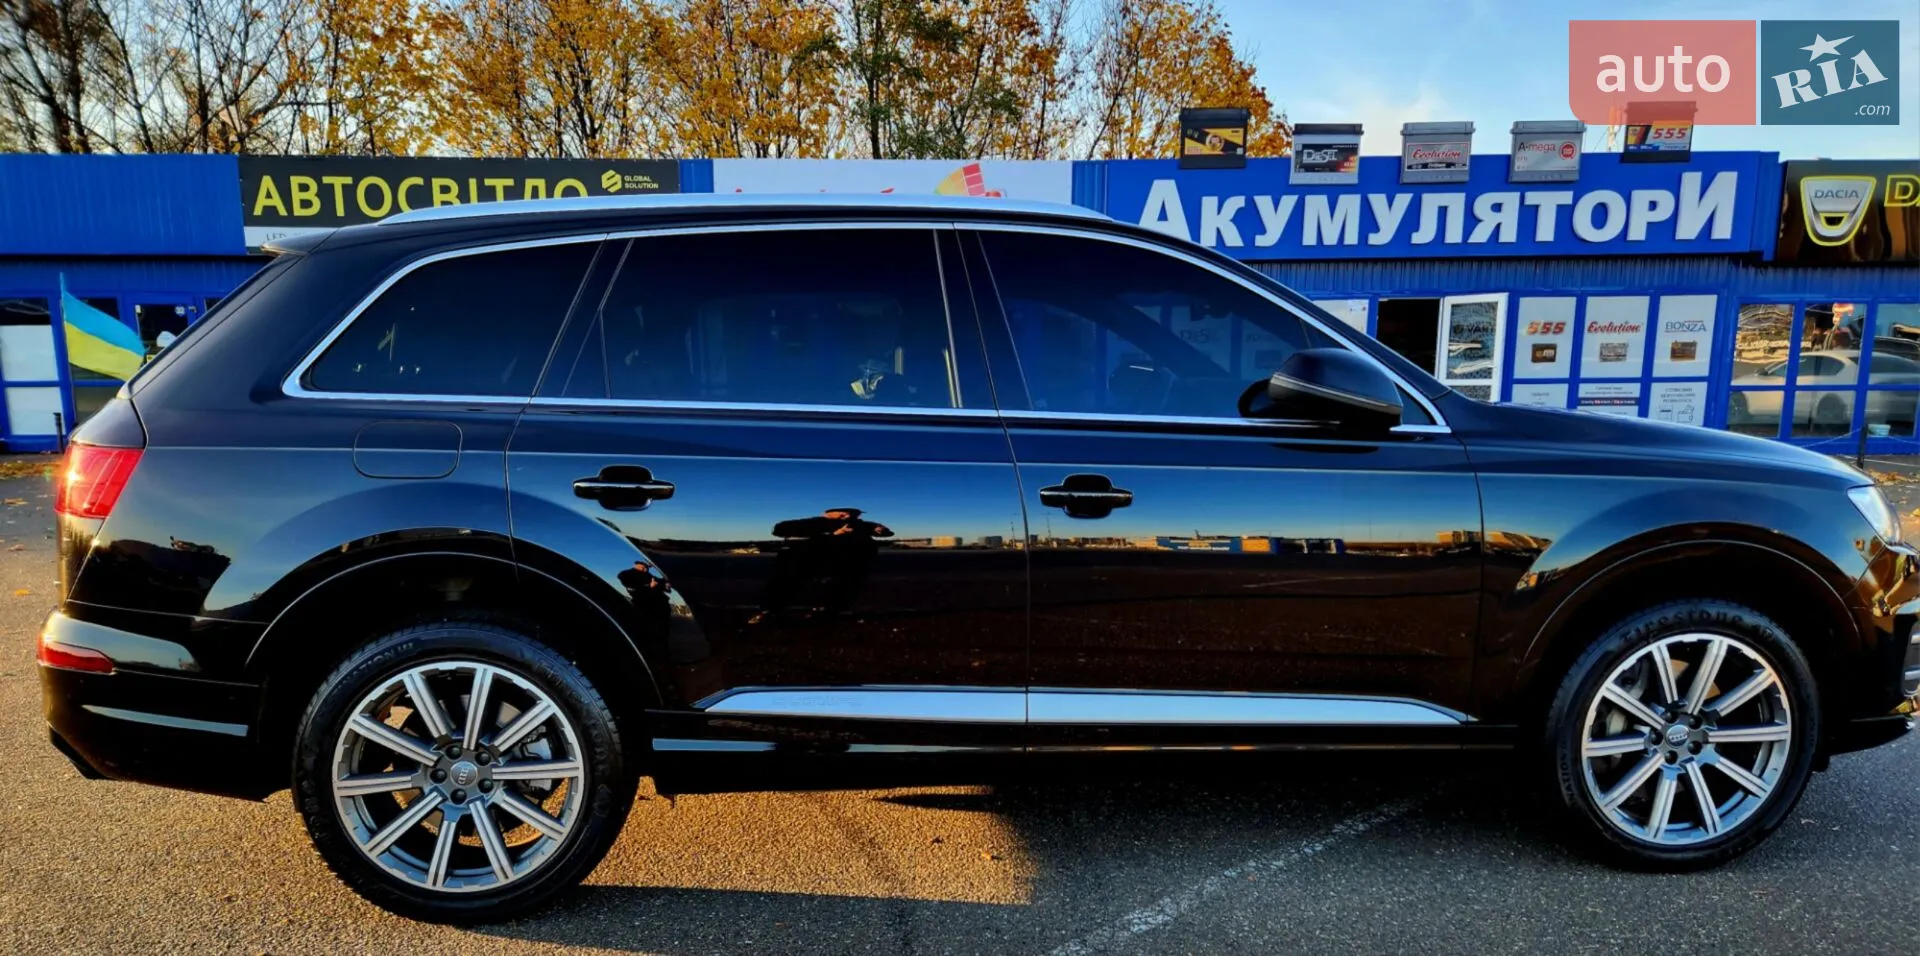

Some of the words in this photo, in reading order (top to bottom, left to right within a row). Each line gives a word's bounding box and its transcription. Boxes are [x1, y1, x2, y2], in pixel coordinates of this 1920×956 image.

[1652, 128, 1688, 139] 555
[1814, 189, 1859, 199] DACIA
[1884, 174, 1920, 207] D
[1587, 321, 1641, 334] Evolution
[1665, 321, 1708, 333] BONZA
